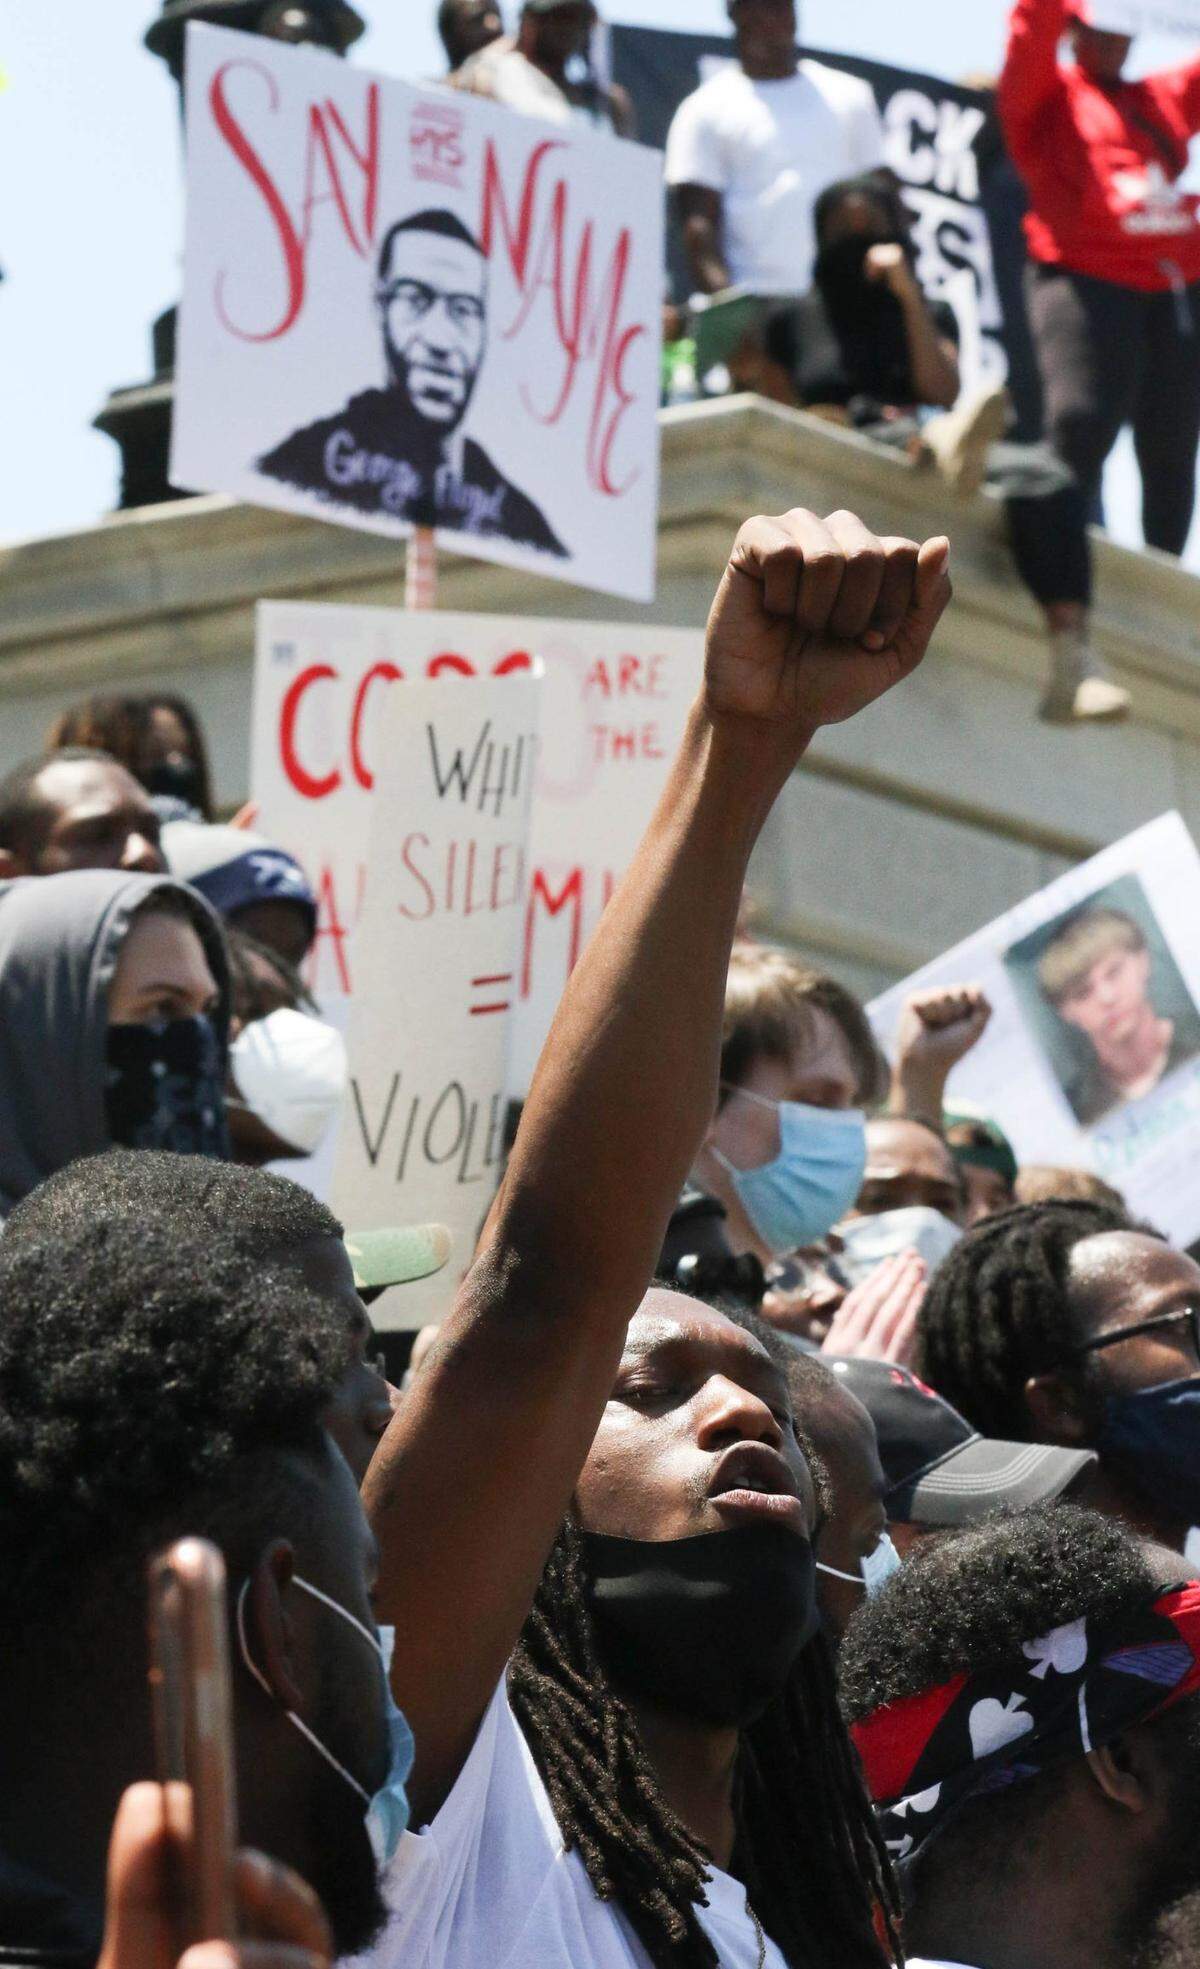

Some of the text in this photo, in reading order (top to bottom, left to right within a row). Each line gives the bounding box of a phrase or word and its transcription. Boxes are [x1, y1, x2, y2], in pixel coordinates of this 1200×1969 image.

[884, 88, 987, 201] CK
[208, 57, 379, 343] SAY
[480, 137, 645, 496] NAME
[580, 653, 670, 700] ARE
[426, 717, 538, 817] WHI
[591, 721, 666, 765] THE
